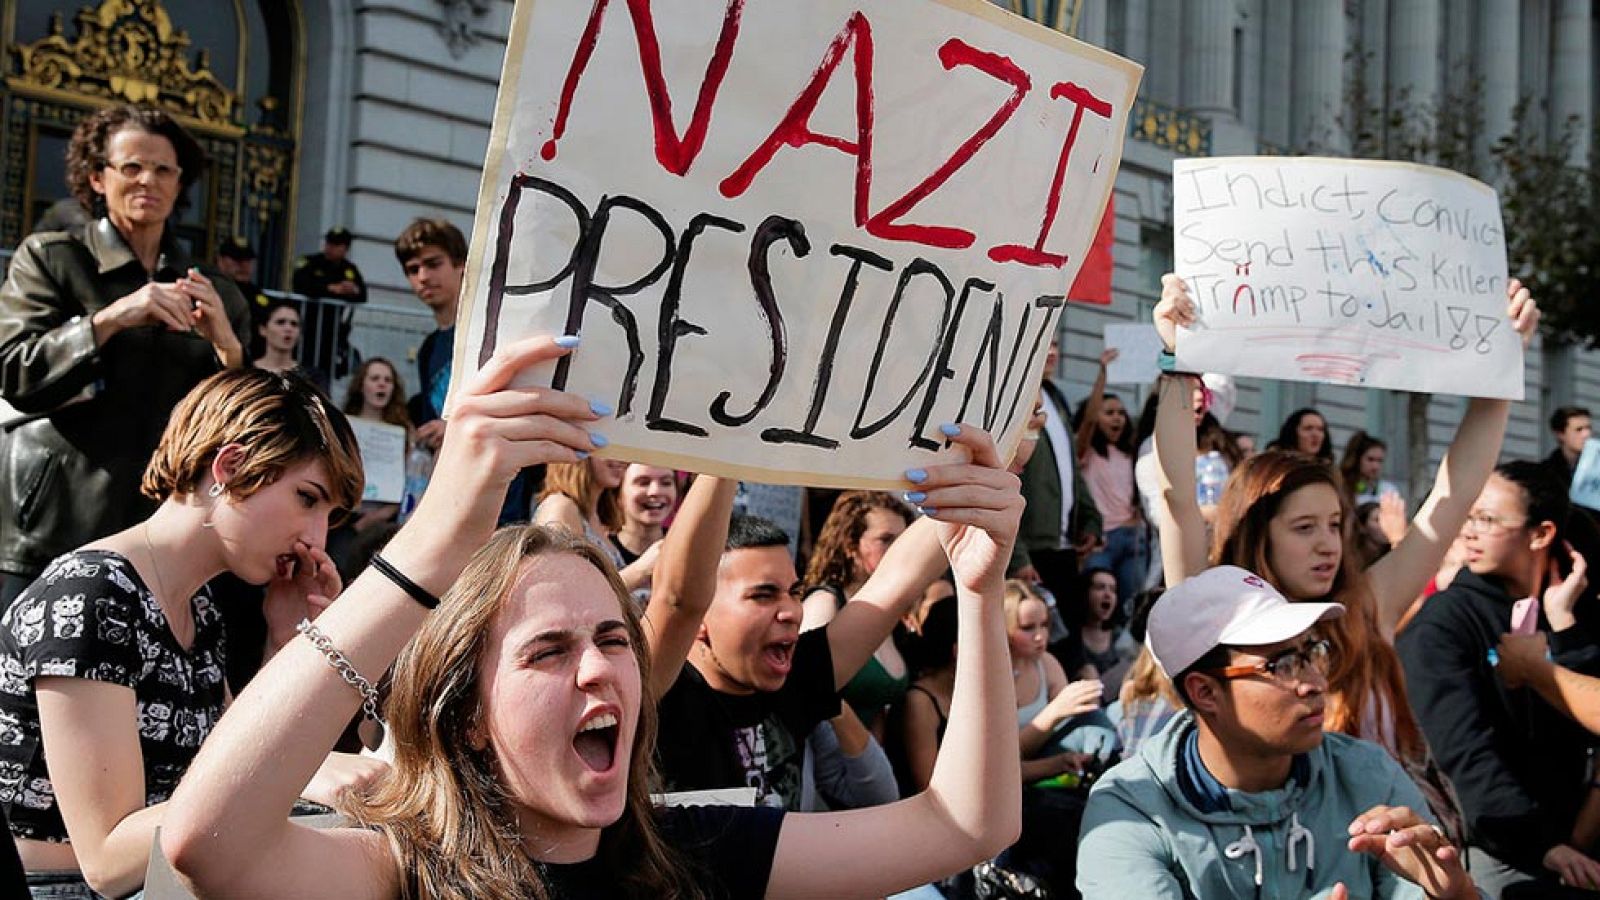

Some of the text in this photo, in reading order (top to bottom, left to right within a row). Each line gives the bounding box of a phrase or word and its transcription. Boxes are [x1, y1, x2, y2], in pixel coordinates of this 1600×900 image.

[541, 0, 1112, 267] NAZI
[1181, 166, 1368, 220] Indict,
[1180, 222, 1293, 266] Send
[1305, 229, 1417, 291] this
[478, 173, 1065, 451] PRESIDENT
[1317, 280, 1359, 318] to
